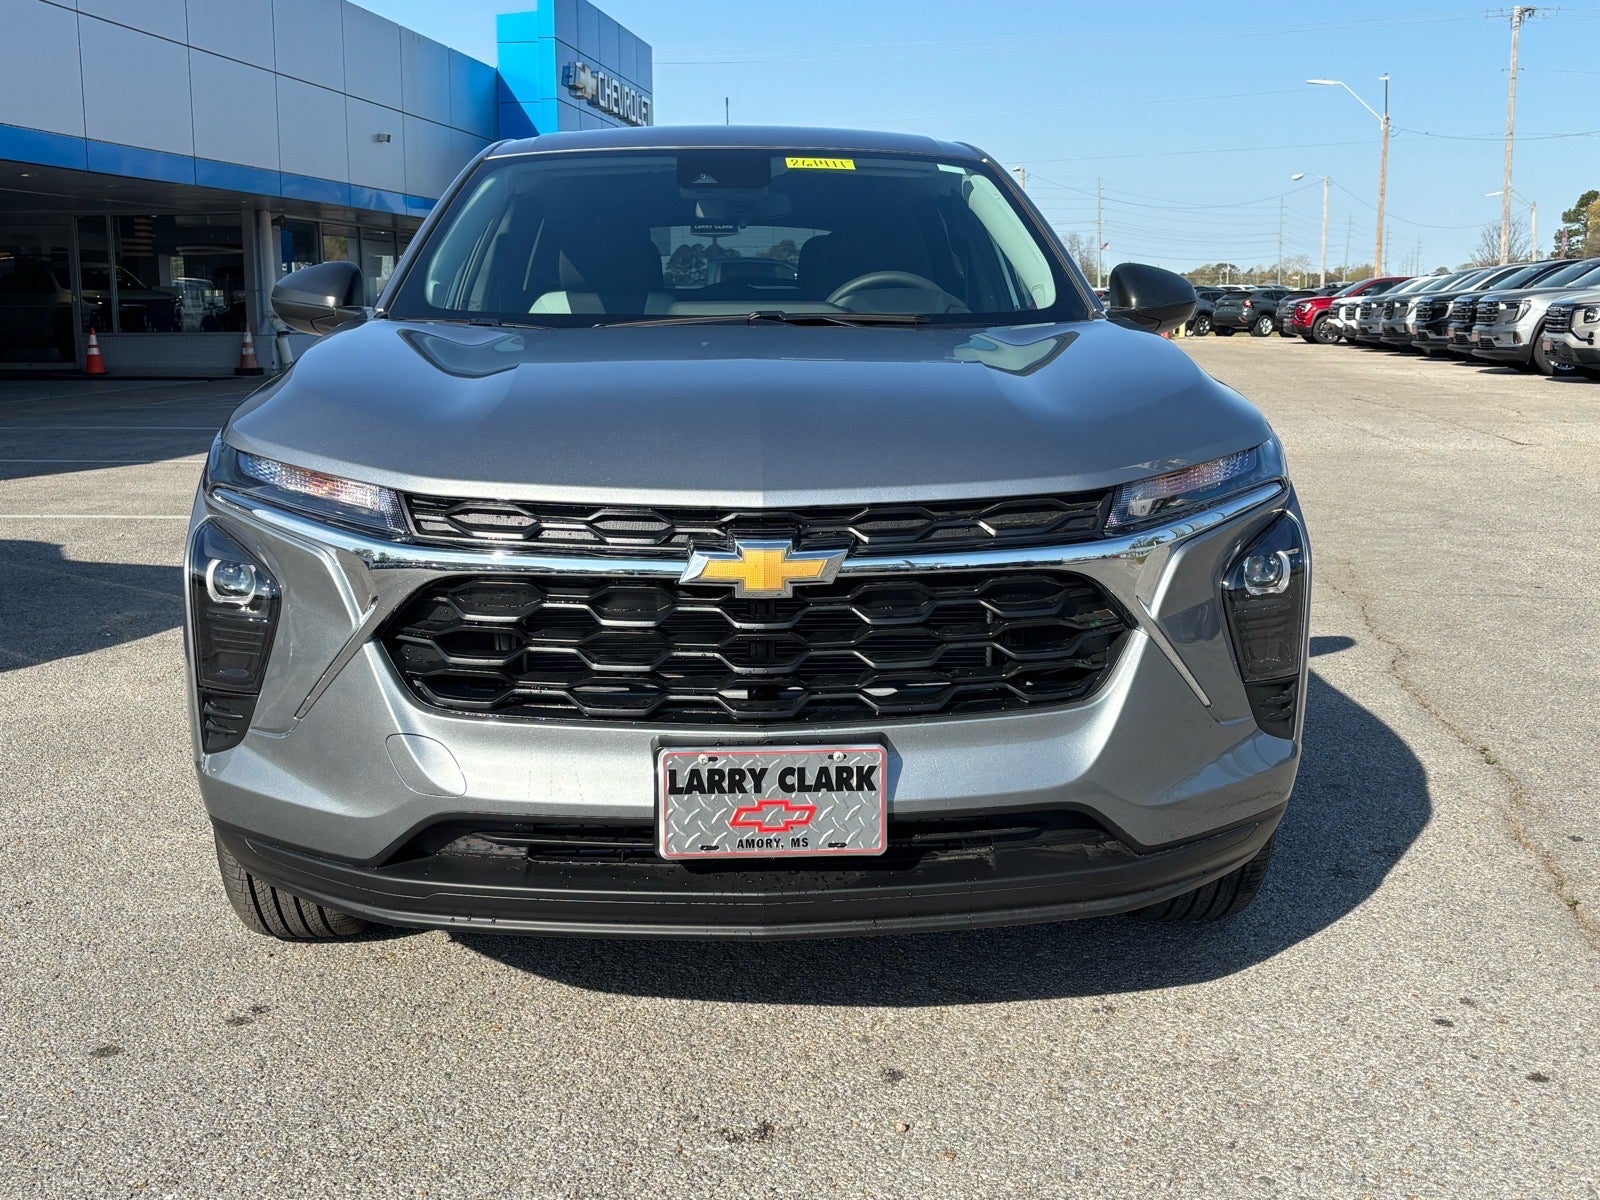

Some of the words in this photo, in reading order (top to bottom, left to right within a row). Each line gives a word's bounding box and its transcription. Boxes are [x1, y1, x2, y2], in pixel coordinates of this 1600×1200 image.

[598, 71, 652, 126] CHEVROLET
[668, 767, 768, 795] LARRY
[777, 765, 877, 793] CLARK
[736, 838, 784, 849] AMORY,
[790, 837, 809, 848] MS
